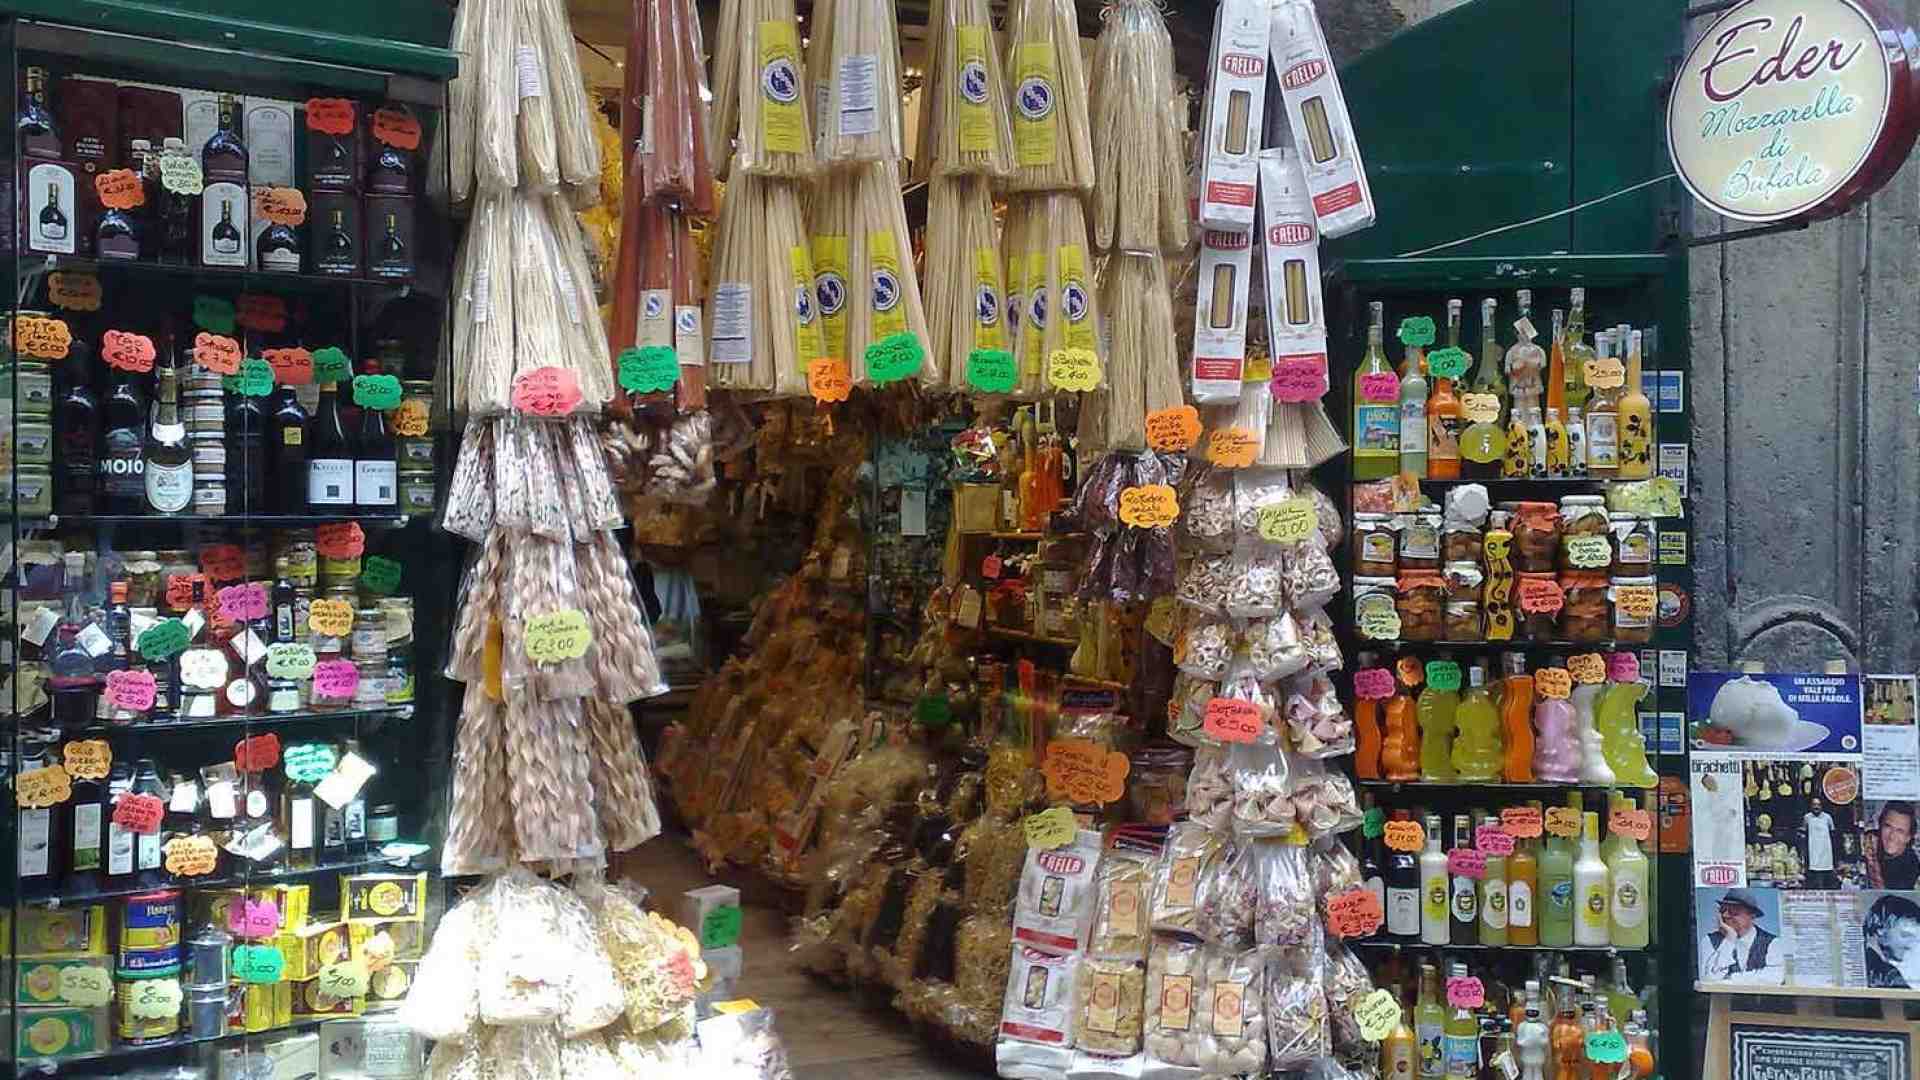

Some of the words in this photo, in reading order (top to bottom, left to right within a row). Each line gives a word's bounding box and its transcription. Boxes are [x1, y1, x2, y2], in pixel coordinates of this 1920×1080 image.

[1700, 16, 1863, 103] Eder
[1700, 85, 1856, 139] Mozzarella
[1760, 130, 1791, 159] di
[1727, 156, 1824, 199] Bufala
[1272, 226, 1311, 244] FAELLA
